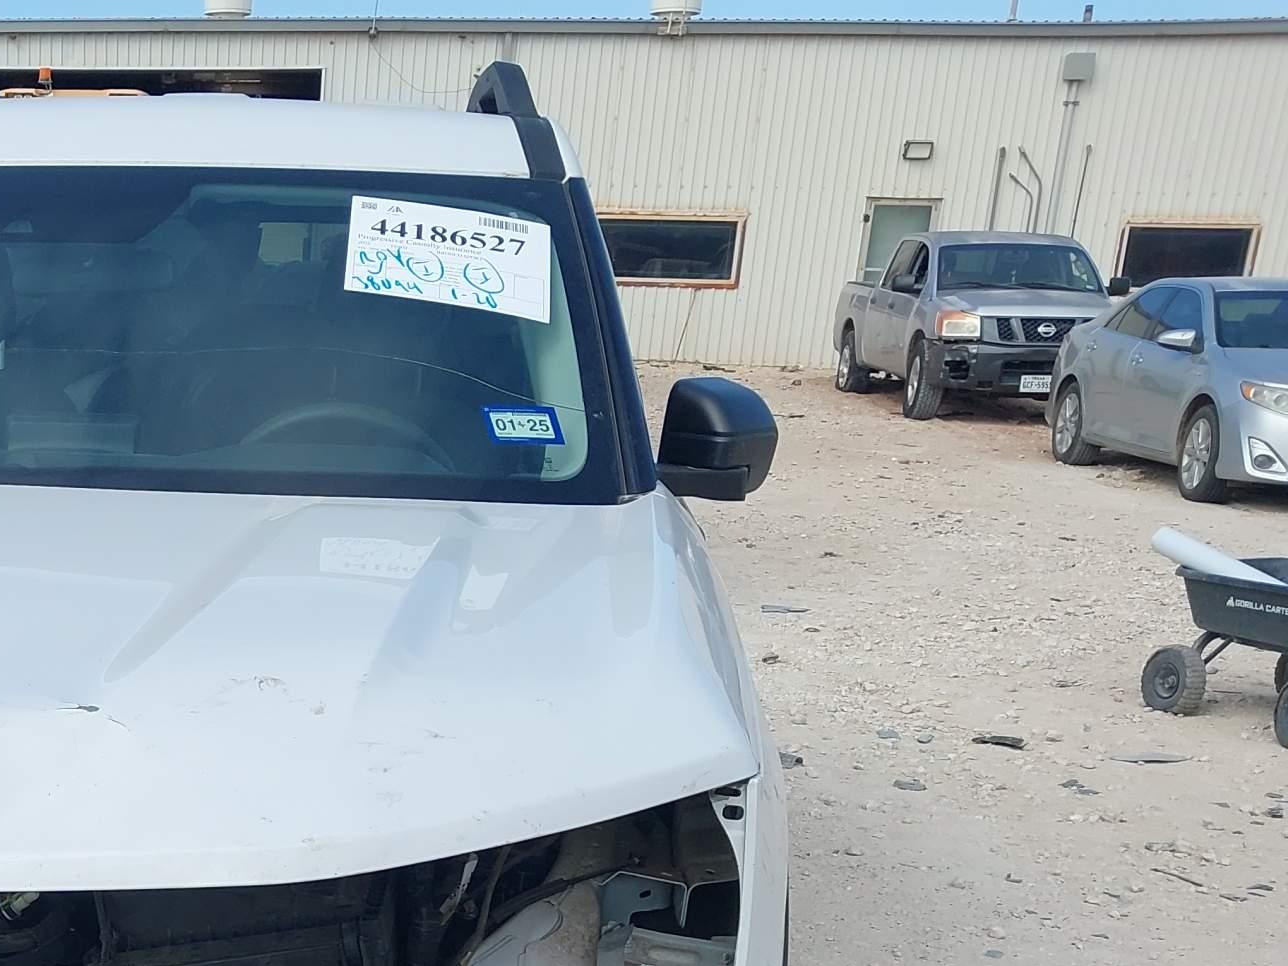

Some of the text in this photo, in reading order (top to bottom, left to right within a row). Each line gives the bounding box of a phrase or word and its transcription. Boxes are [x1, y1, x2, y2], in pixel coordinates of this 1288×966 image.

[371, 218, 526, 256] 44186527
[495, 418, 550, 432] 01 25
[1235, 599, 1264, 611] GORILLA
